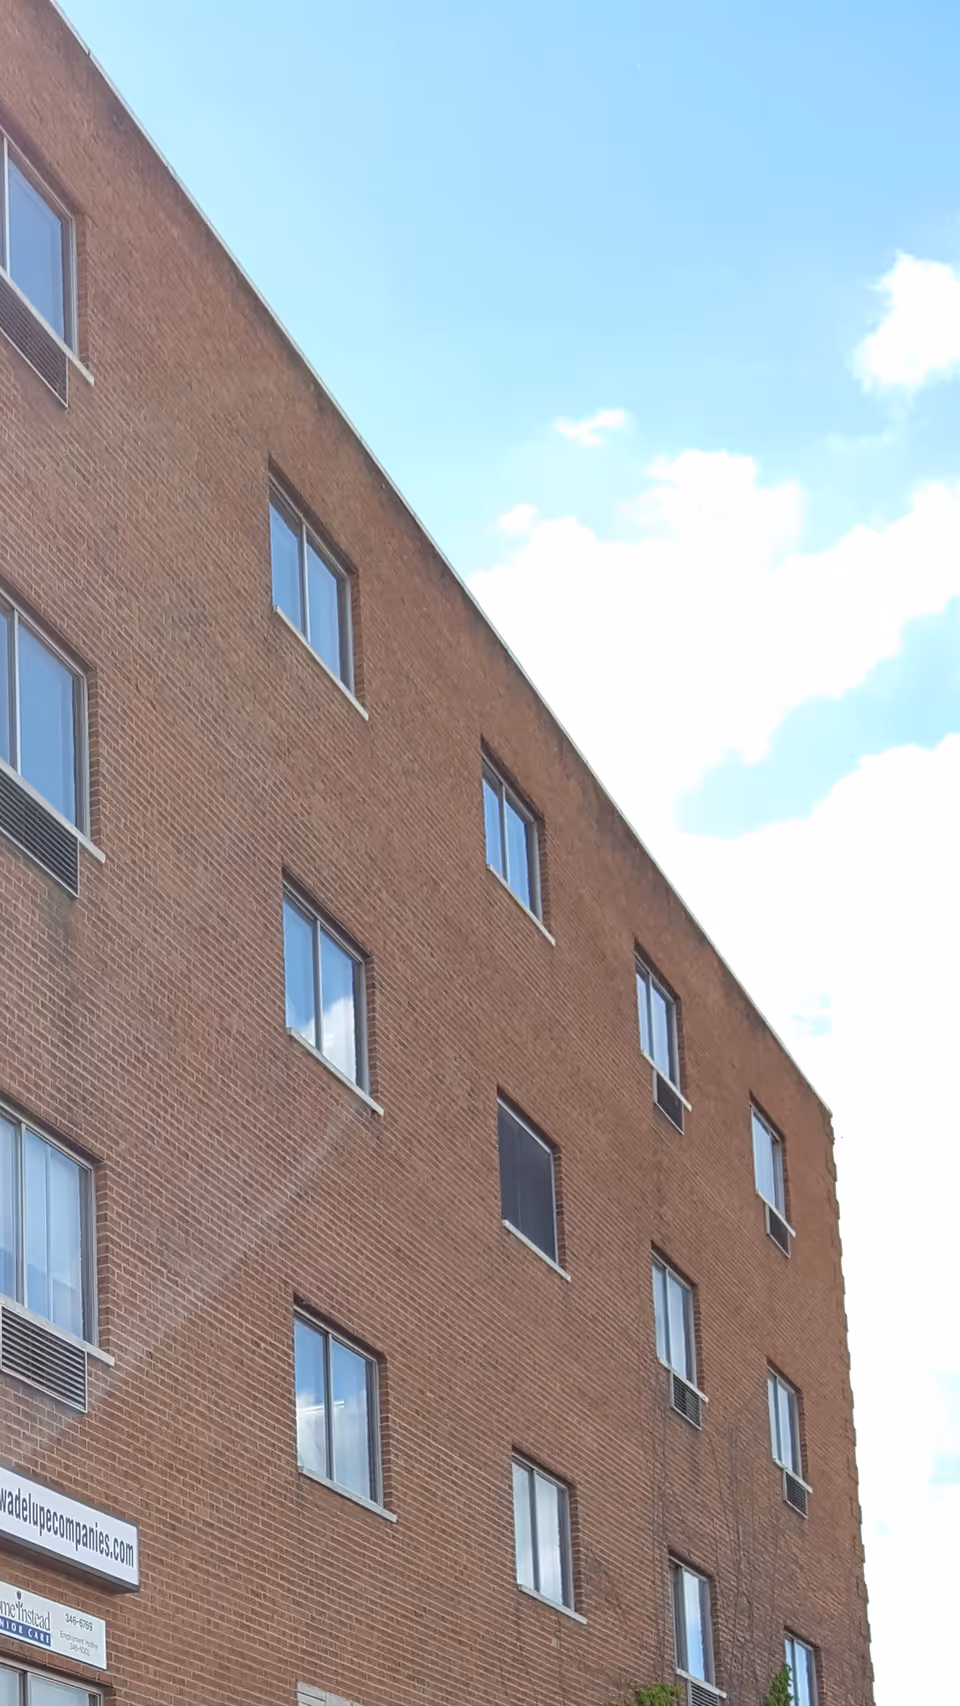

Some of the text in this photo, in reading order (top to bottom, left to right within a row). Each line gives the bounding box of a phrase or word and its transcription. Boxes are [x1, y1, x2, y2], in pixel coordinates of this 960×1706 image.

[17, 1600, 51, 1632] Instead
[64, 1613, 93, 1632] 346-6769
[28, 1628, 50, 1644] CARE
